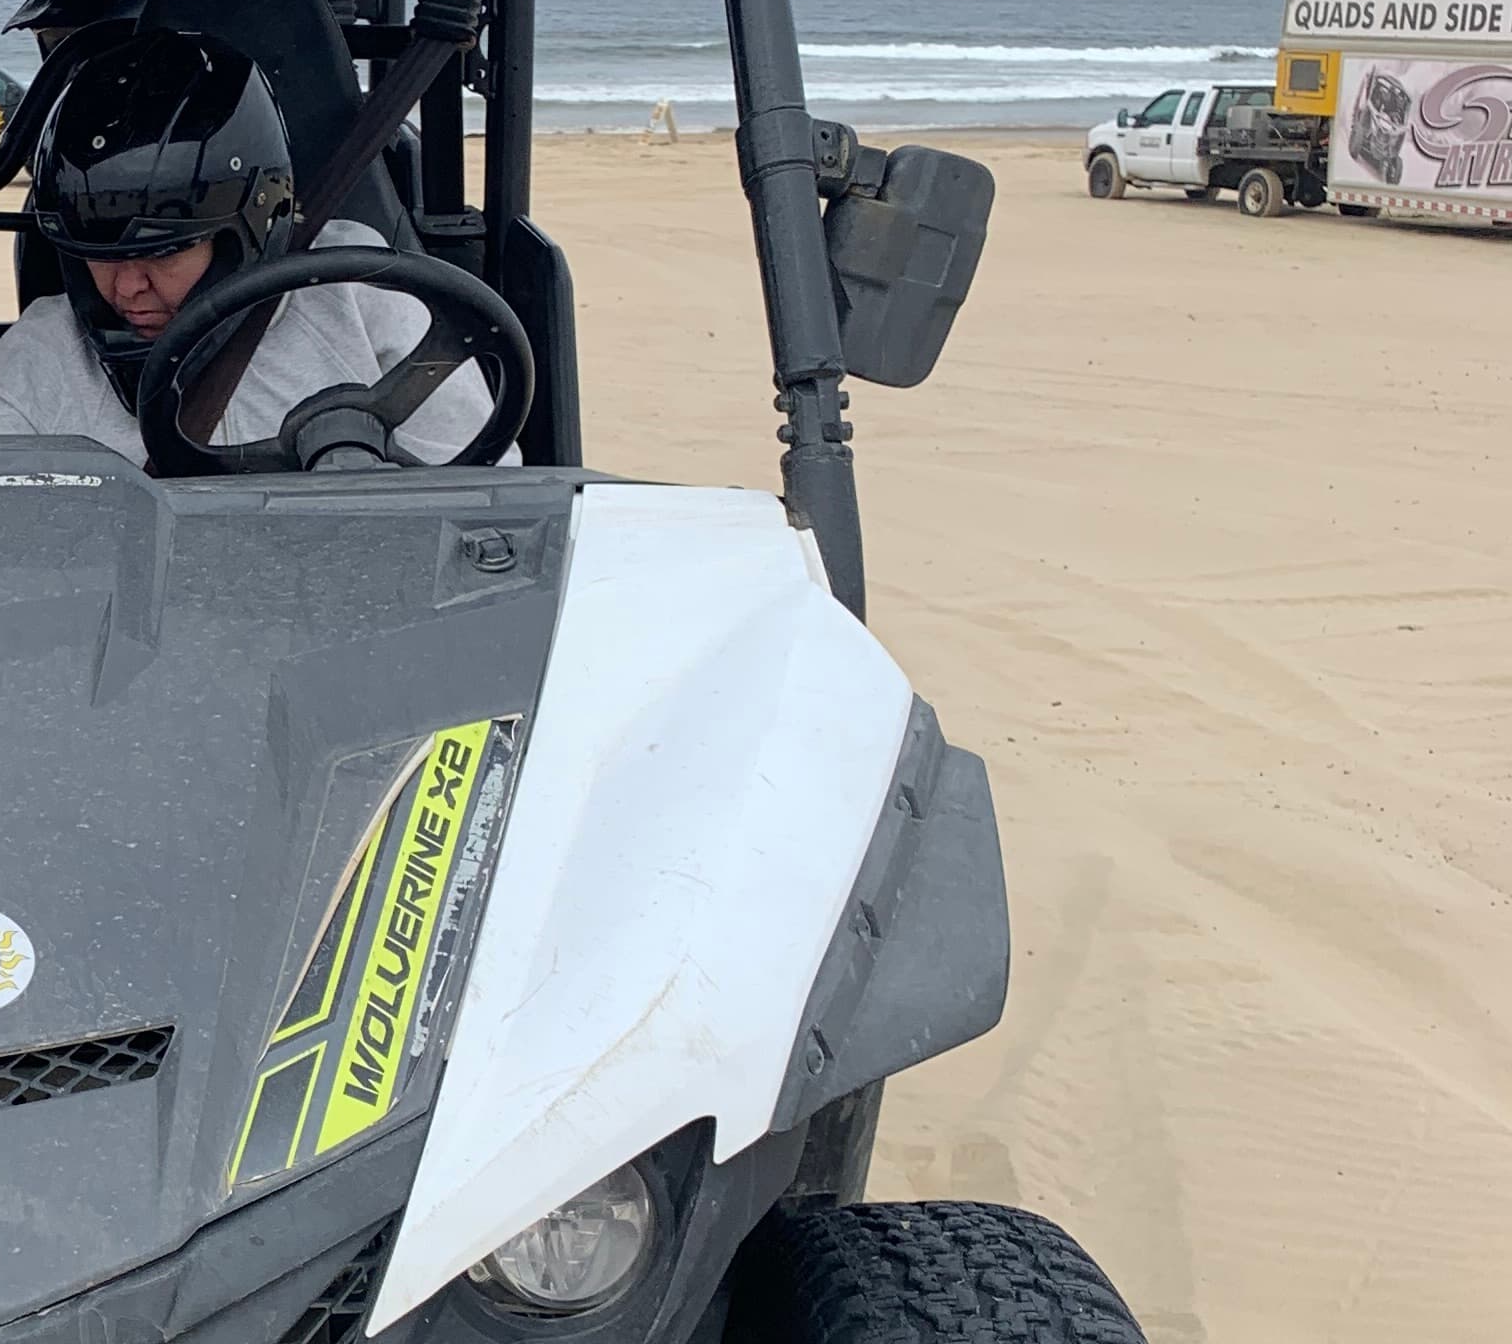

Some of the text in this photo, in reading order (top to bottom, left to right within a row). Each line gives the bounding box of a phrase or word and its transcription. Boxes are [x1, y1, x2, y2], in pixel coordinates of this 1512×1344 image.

[1294, 0, 1504, 33] QUADS AND SIDE
[1436, 142, 1495, 187] ATV
[342, 738, 473, 1107] WOLVERINE X2
